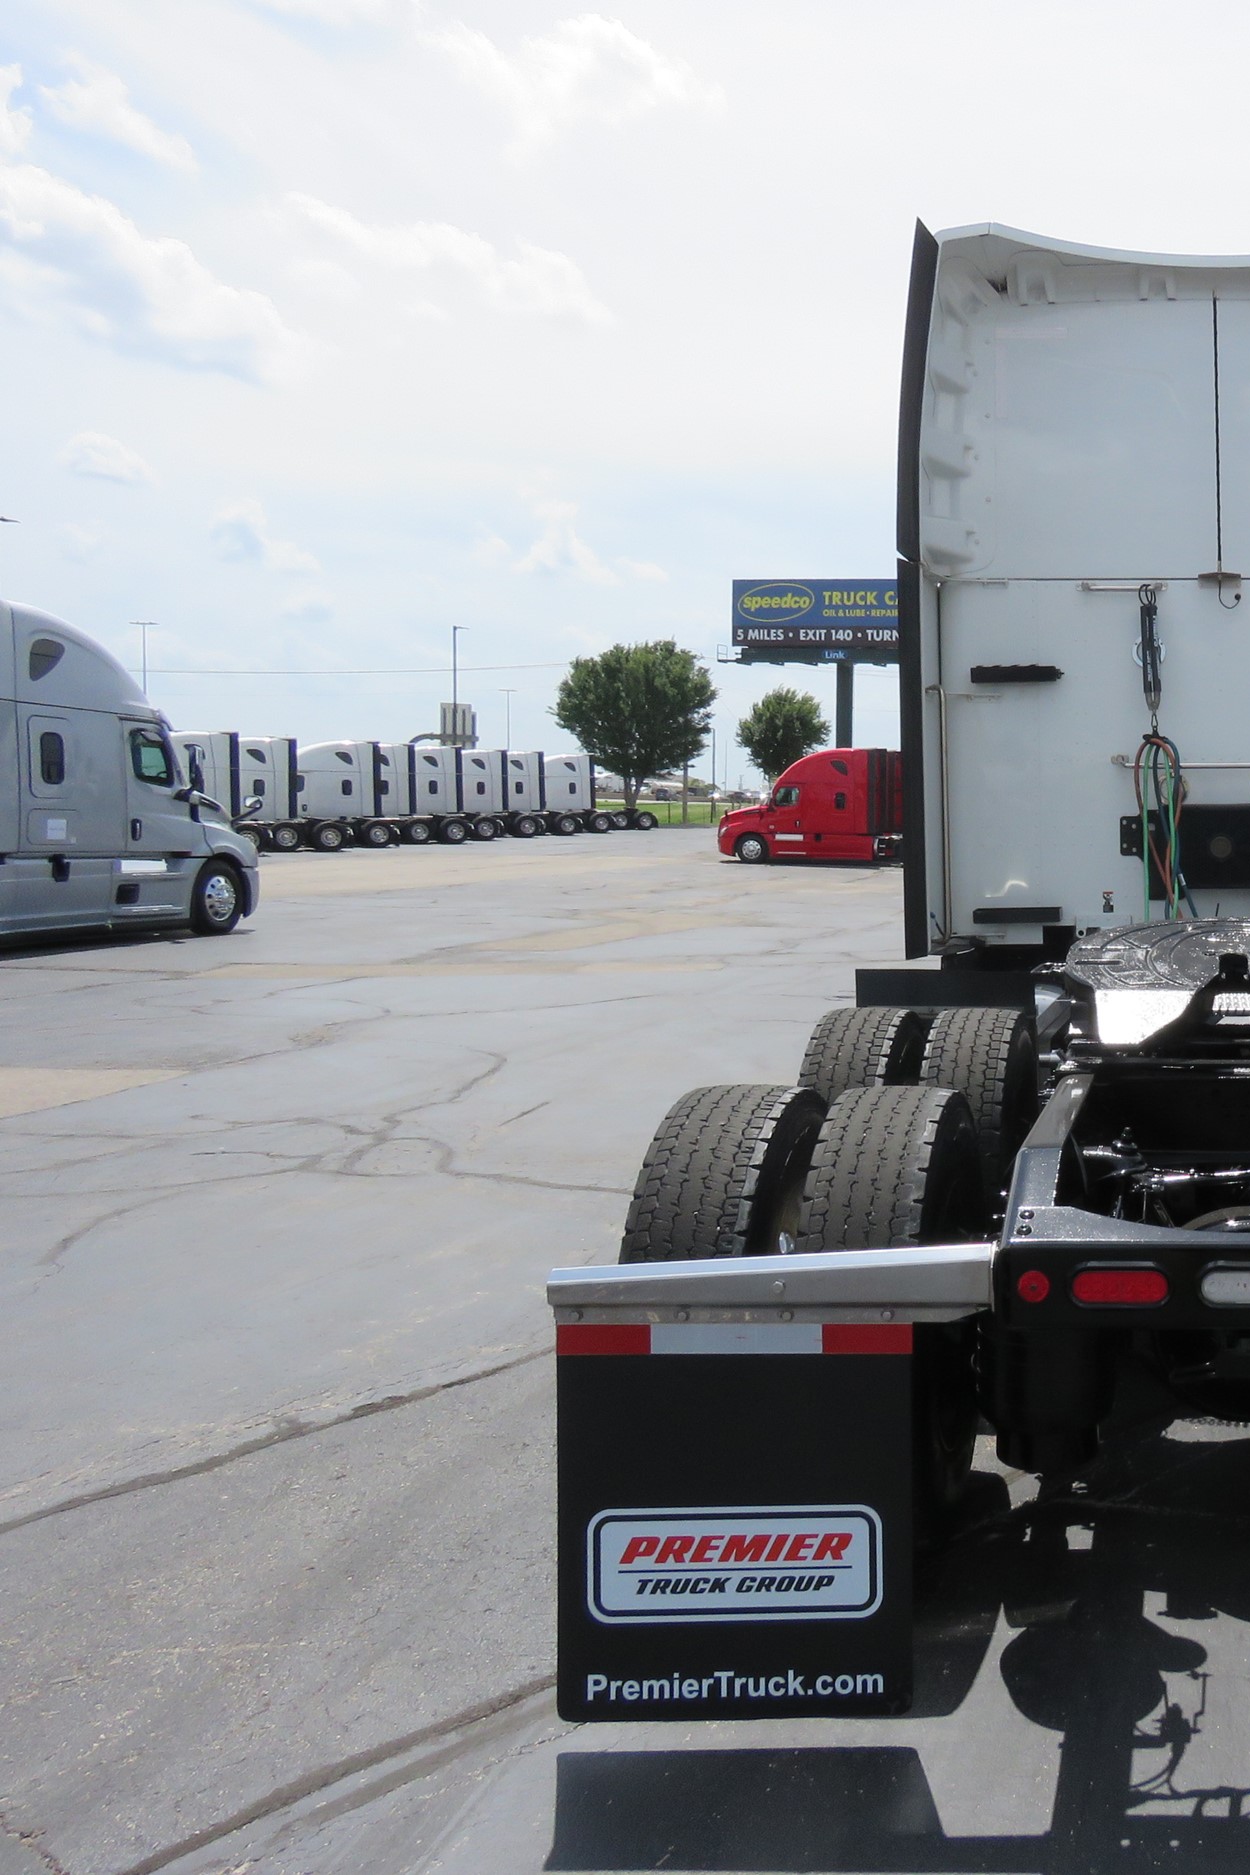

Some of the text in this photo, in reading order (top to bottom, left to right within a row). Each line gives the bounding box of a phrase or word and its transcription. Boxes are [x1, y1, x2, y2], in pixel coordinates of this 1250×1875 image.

[743, 593, 810, 612] speedco
[823, 591, 898, 606] TRUCK C
[823, 609, 836, 617] OIL
[846, 609, 865, 617] LUBE
[736, 629, 899, 641] 5 MILES EXIT 140 TURN
[825, 651, 845, 660] Link
[619, 1533, 853, 1564] PREMIER
[636, 1575, 835, 1595] TRUCK GROUP
[586, 1669, 885, 1701] PremierTruck.com
